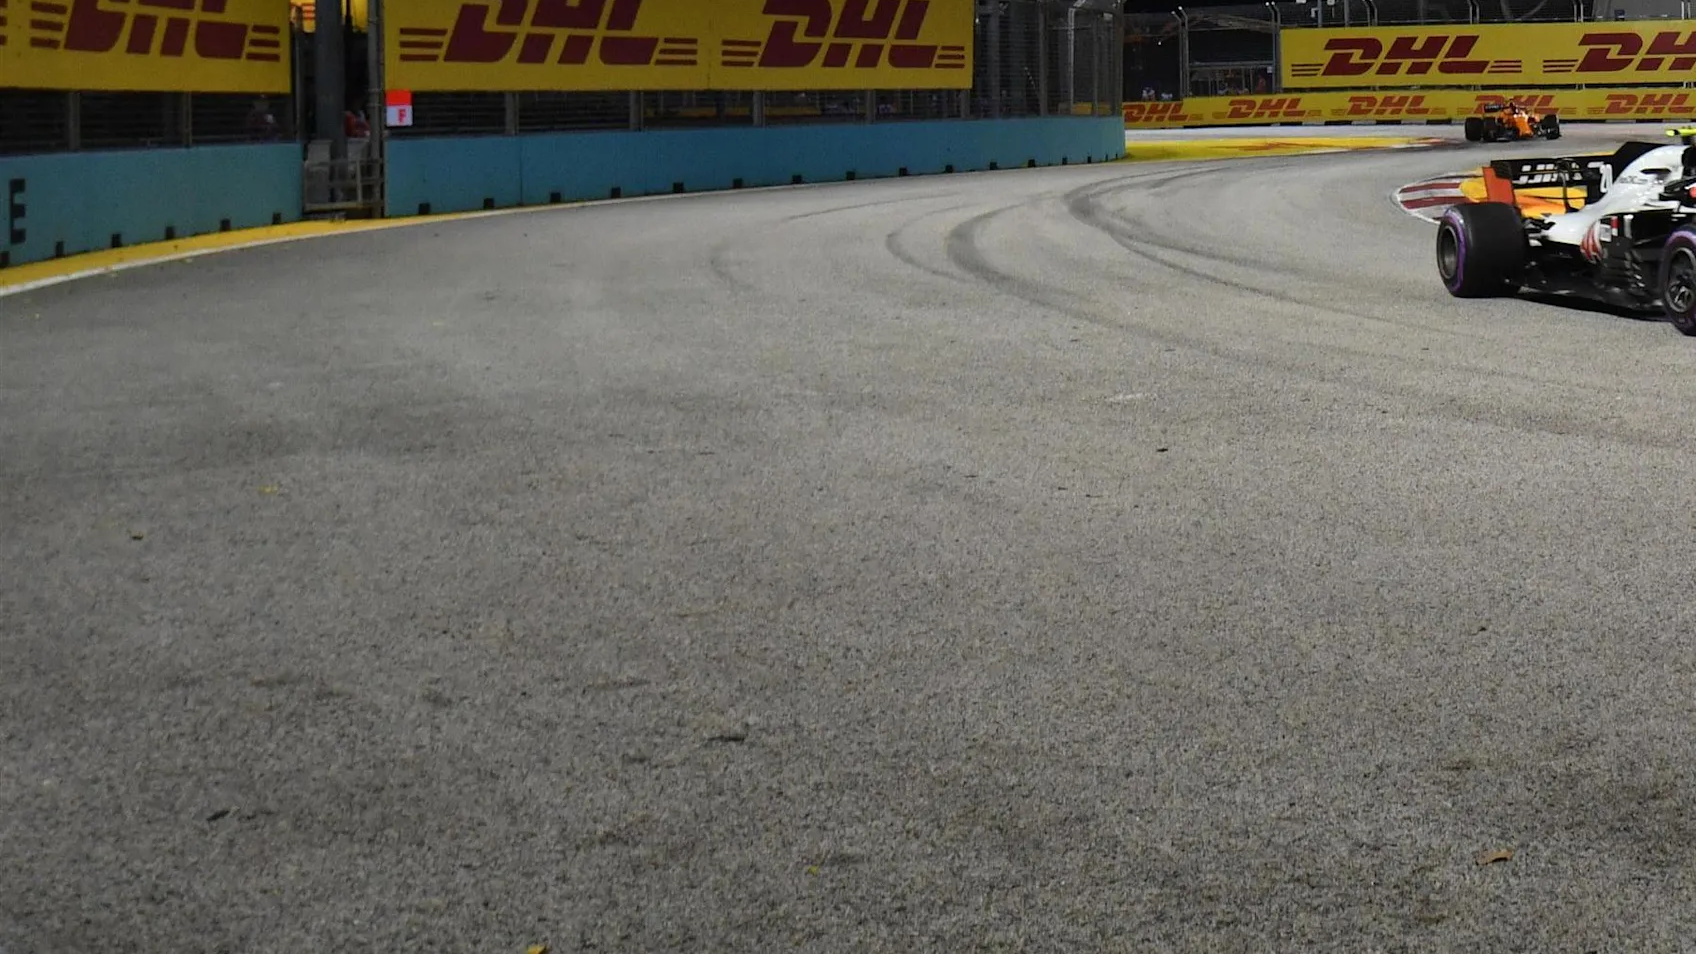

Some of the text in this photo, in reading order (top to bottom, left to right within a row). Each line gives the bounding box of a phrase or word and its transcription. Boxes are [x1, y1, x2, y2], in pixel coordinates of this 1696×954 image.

[1322, 34, 1490, 76] DHL
[1123, 102, 1187, 123] DHL
[1228, 98, 1306, 119] DHL
[1347, 95, 1432, 115] DHL
[1604, 93, 1696, 114] DHL
[9, 178, 25, 244] E
